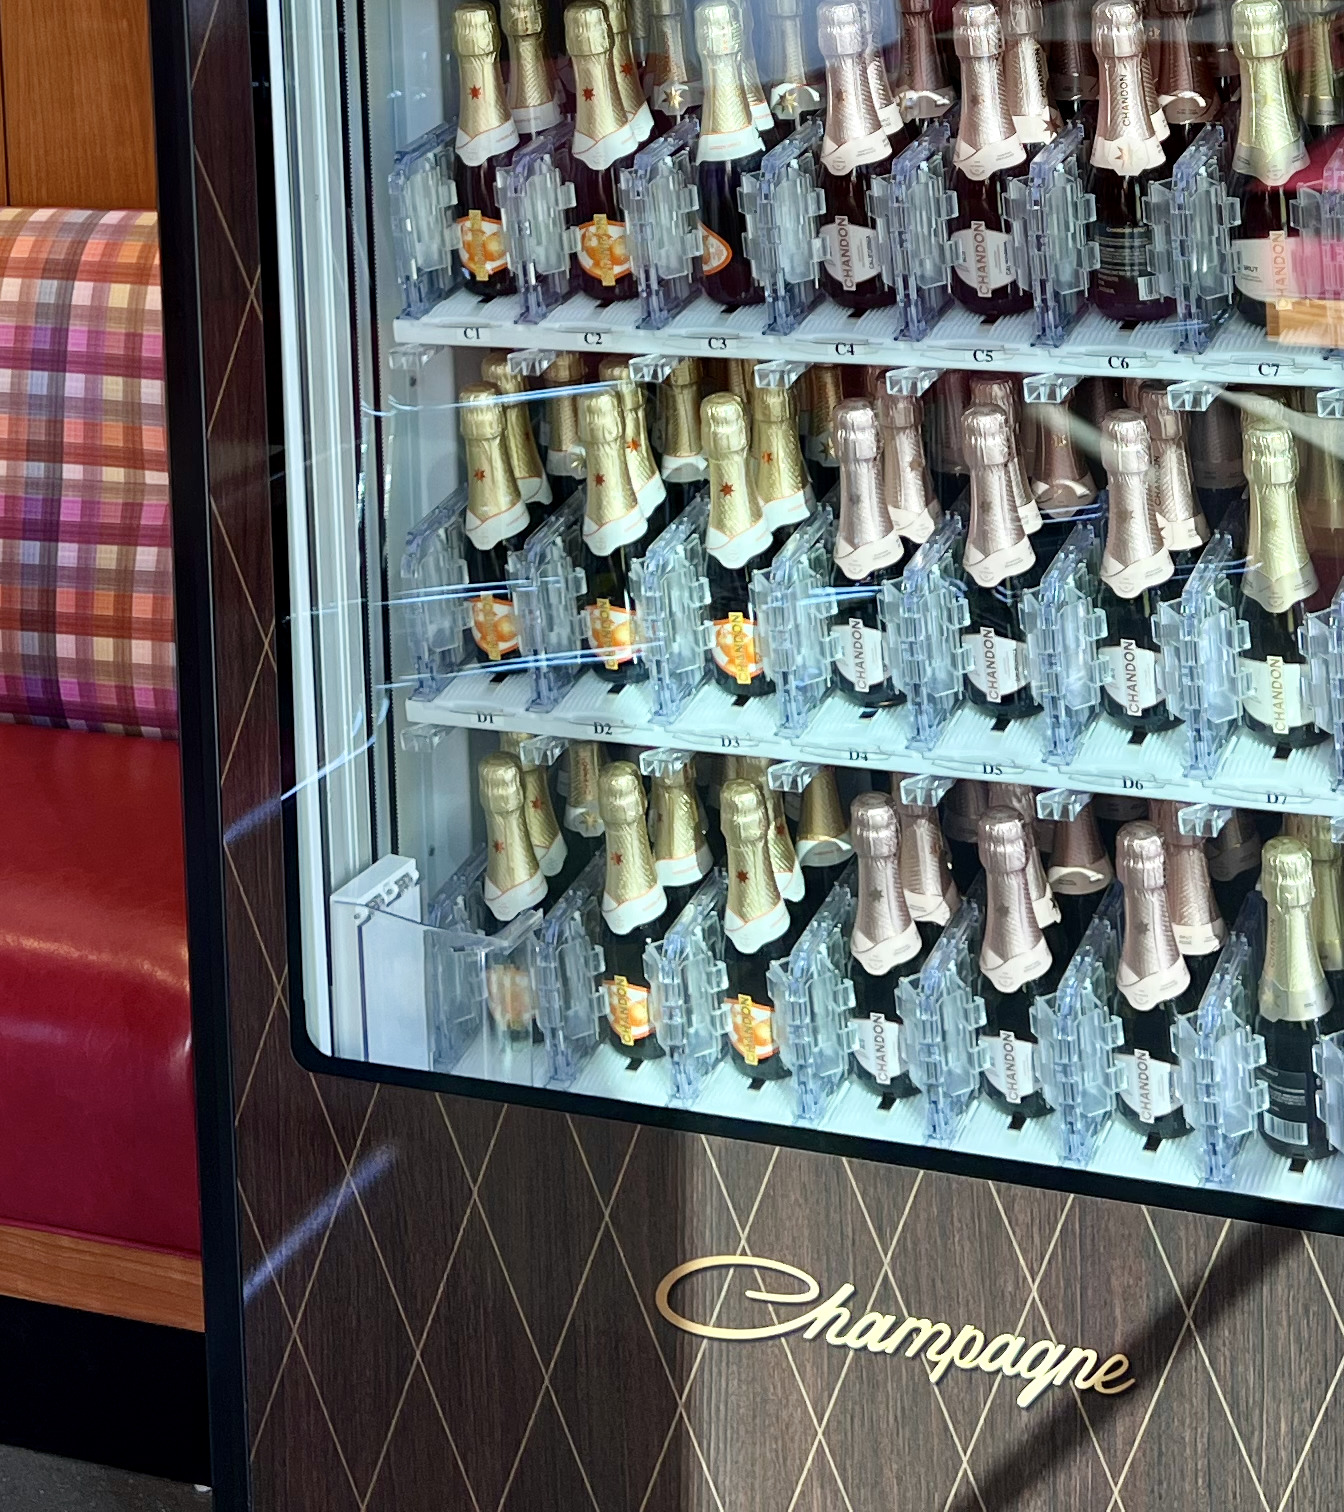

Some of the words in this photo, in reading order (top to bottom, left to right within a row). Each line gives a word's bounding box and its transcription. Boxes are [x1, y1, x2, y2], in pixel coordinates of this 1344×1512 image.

[1035, 47, 1047, 99] CHANDON
[1119, 74, 1132, 127] CHANDON
[837, 216, 854, 289] CHANDON
[973, 222, 990, 296] CHANDON
[1271, 231, 1290, 309] CHANDON
[463, 327, 481, 340] C1
[583, 332, 603, 346] C2
[707, 336, 728, 350] C3
[835, 342, 855, 357] C4
[972, 348, 994, 363] C5
[1107, 355, 1130, 370] C6
[1257, 362, 1281, 377] C7
[731, 613, 749, 683] CHANDON
[851, 619, 868, 690] CHANDON
[982, 628, 999, 700] CHANDON
[1123, 641, 1140, 714] CHANDON
[1269, 657, 1286, 732] CHANDON
[476, 711, 495, 724] D1
[593, 721, 613, 736] D2
[720, 734, 741, 748] D3
[982, 763, 1003, 776] D5
[1122, 775, 1144, 791] D6
[1266, 792, 1288, 804] D7
[616, 978, 632, 1044] CHANDON
[740, 996, 756, 1064] CHANDON
[871, 1014, 888, 1082] CHANDON
[1002, 1032, 1019, 1102] CHANDON
[1136, 1051, 1154, 1121] CHANDON
[656, 1254, 1136, 1408] Champagne
